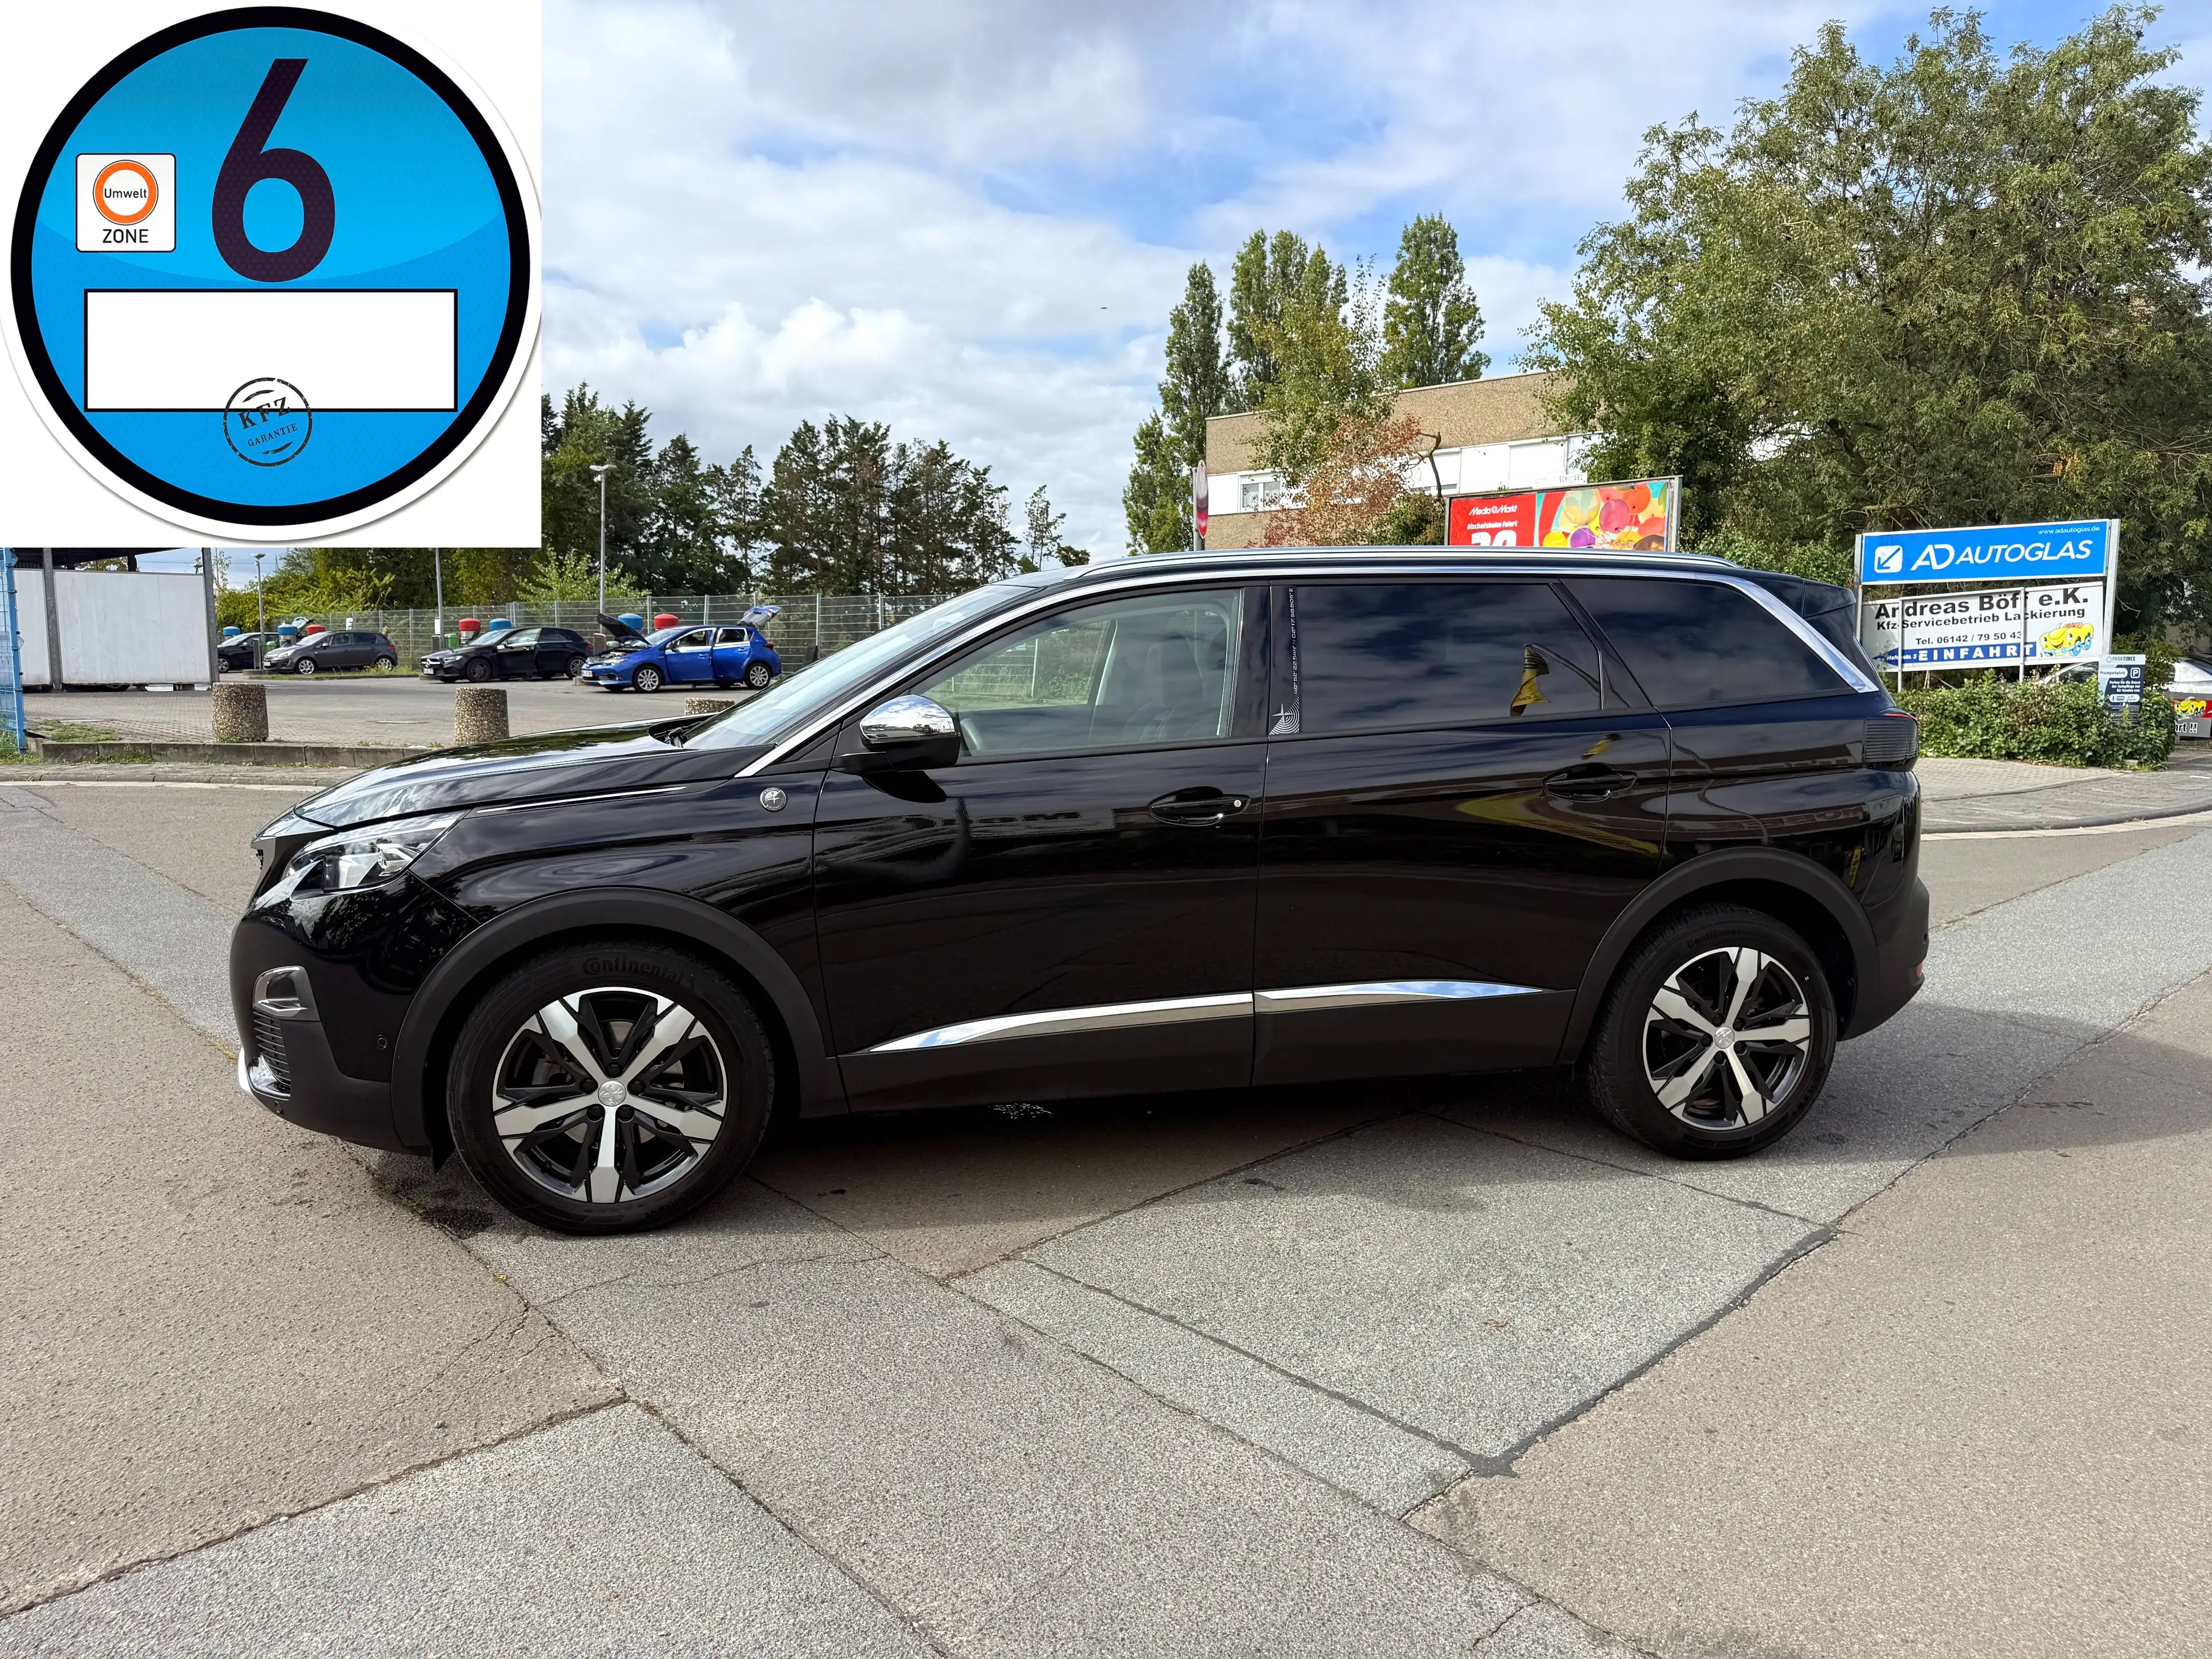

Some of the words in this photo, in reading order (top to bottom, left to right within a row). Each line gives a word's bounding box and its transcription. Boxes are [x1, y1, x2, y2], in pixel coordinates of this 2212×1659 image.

[2037, 525, 2100, 535] www.adautoglas.de
[1910, 544, 1955, 571] AD
[1955, 540, 2092, 565] AUTOGLAS
[2039, 588, 2088, 606] e.K.
[2005, 608, 2085, 622] Lackierung
[1915, 637, 1933, 645] Tel.
[1937, 635, 1968, 644] 06142
[1978, 634, 1990, 642] 79
[1994, 632, 2006, 641] 50
[1919, 644, 2033, 661] EINFAHRT
[582, 955, 682, 984] Continental
